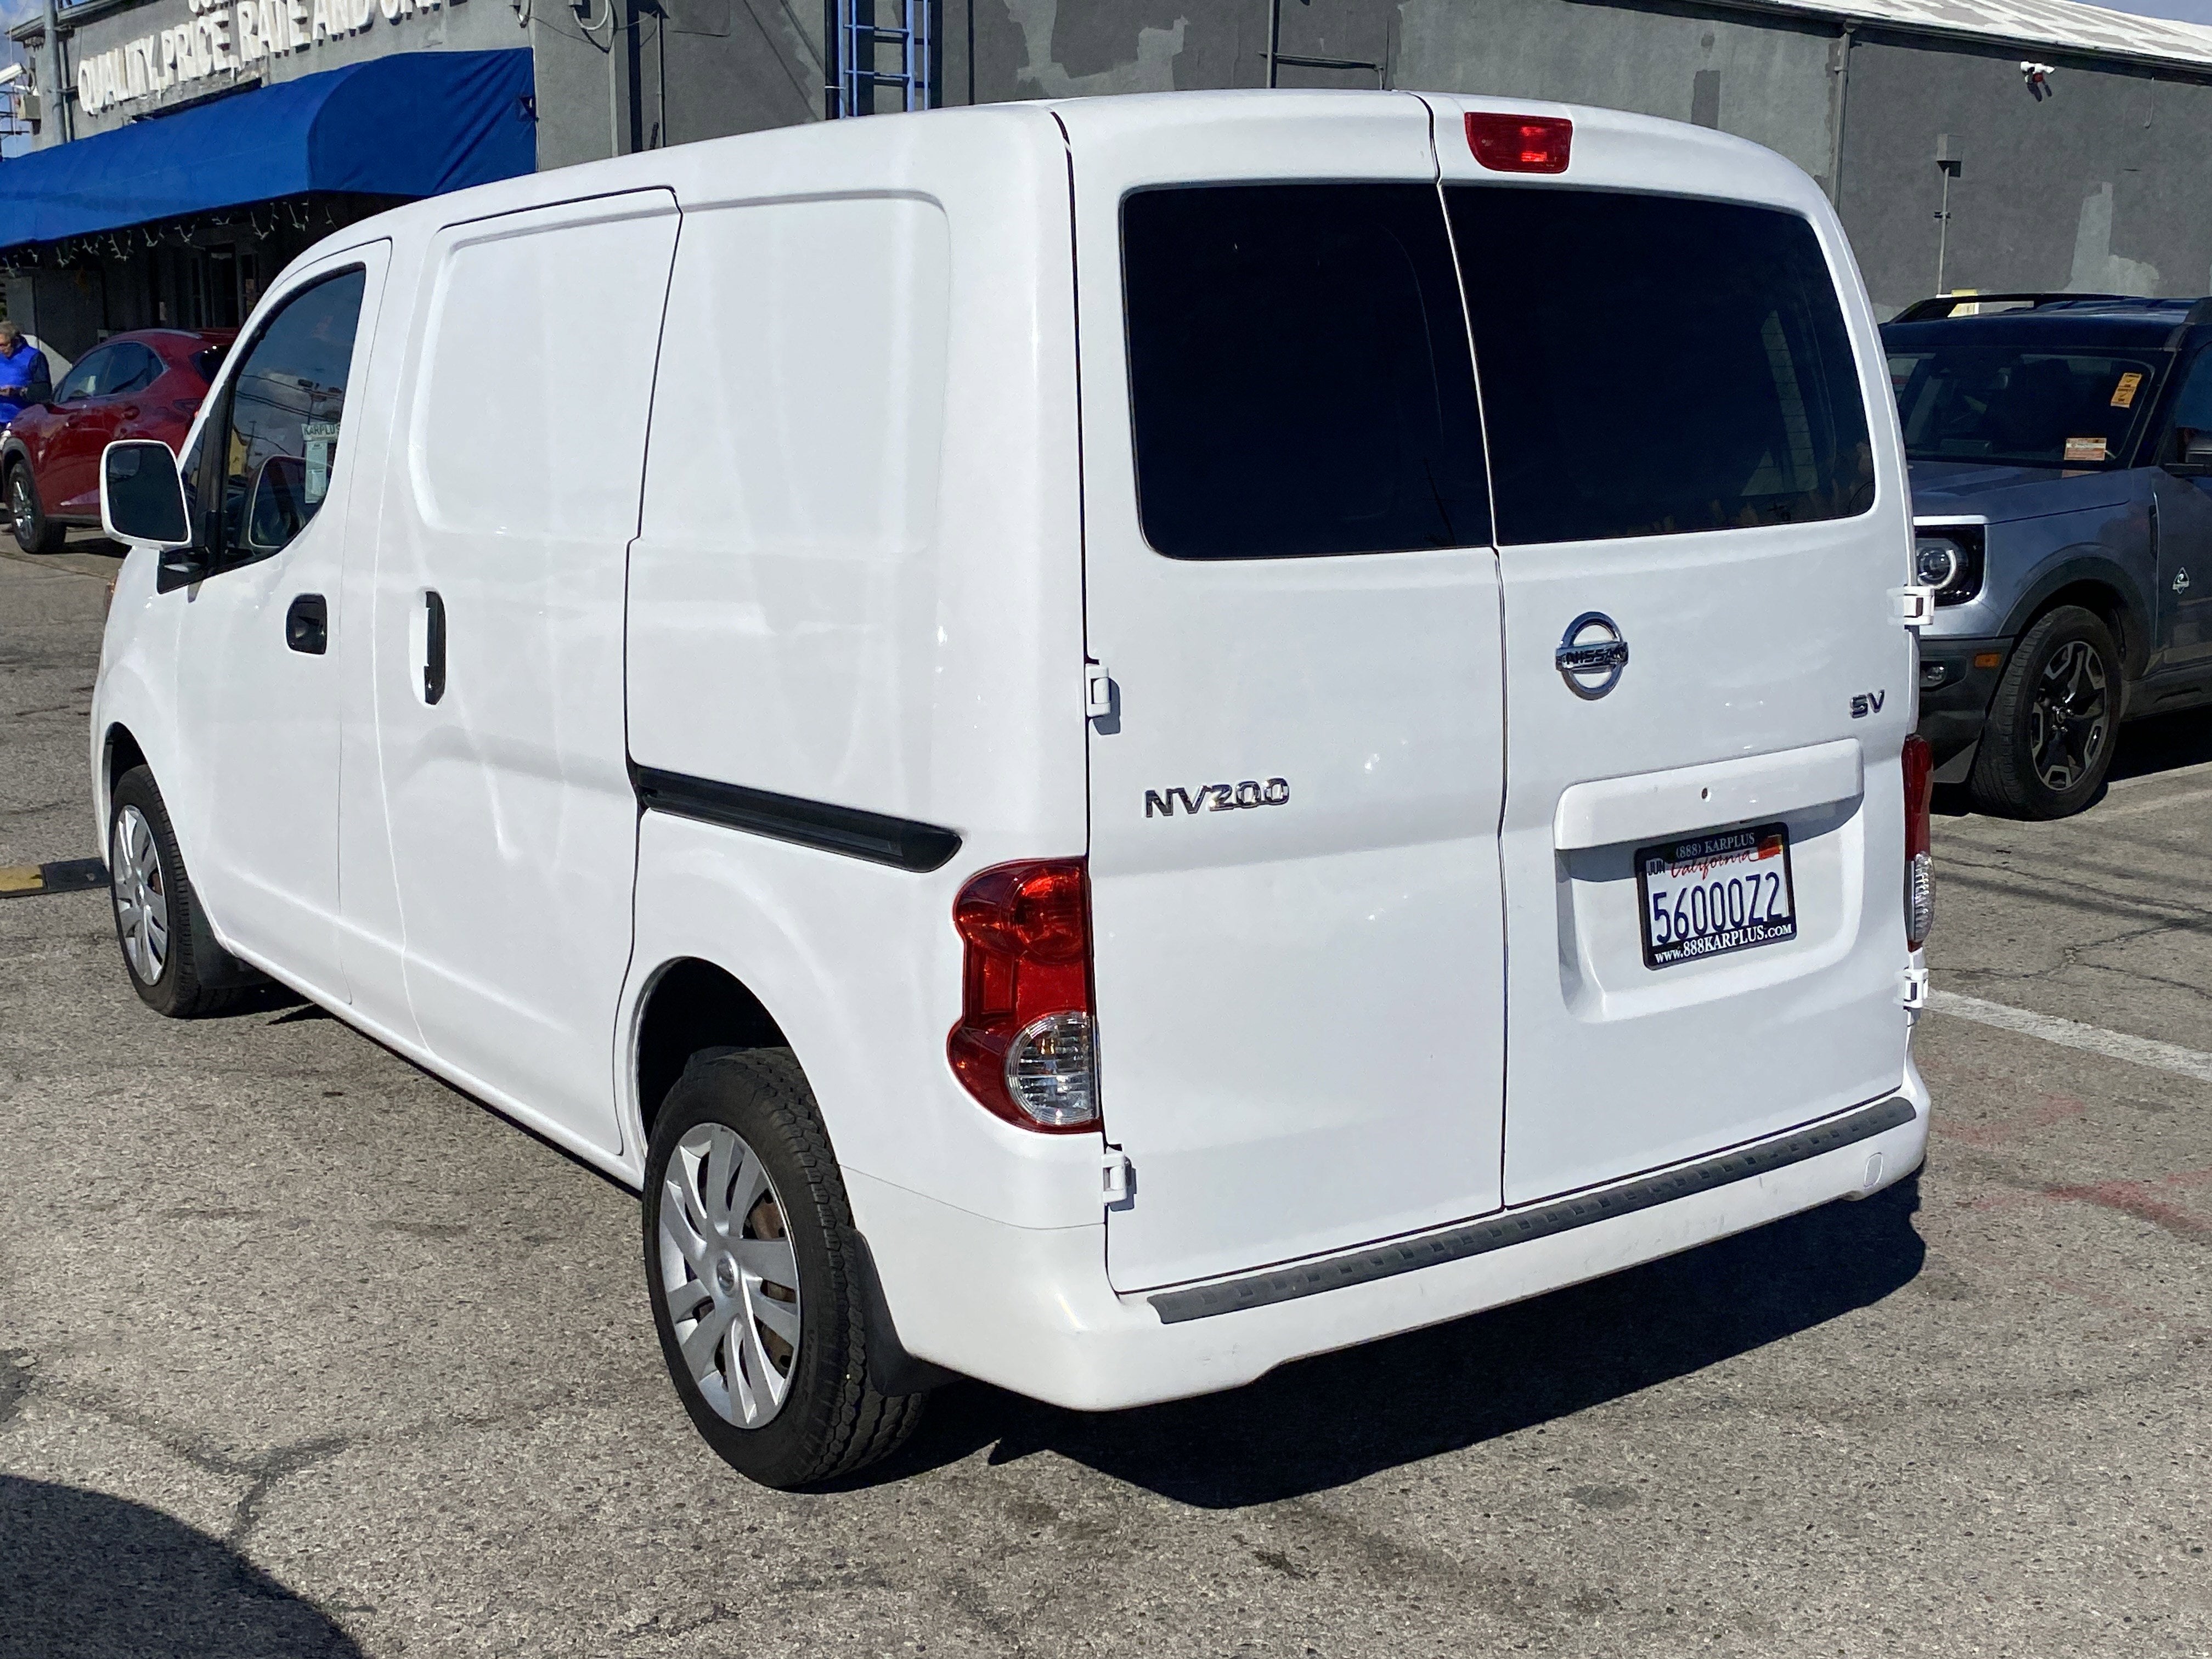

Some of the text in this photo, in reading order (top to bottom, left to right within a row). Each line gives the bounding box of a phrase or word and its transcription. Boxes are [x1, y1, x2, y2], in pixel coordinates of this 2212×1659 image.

[1849, 689, 1885, 719] SV
[1144, 777, 1290, 818] NV200
[1675, 832, 1755, 859] (888) KARPLUS
[1670, 849, 1758, 881] California
[1652, 871, 1782, 944] 56000Z2
